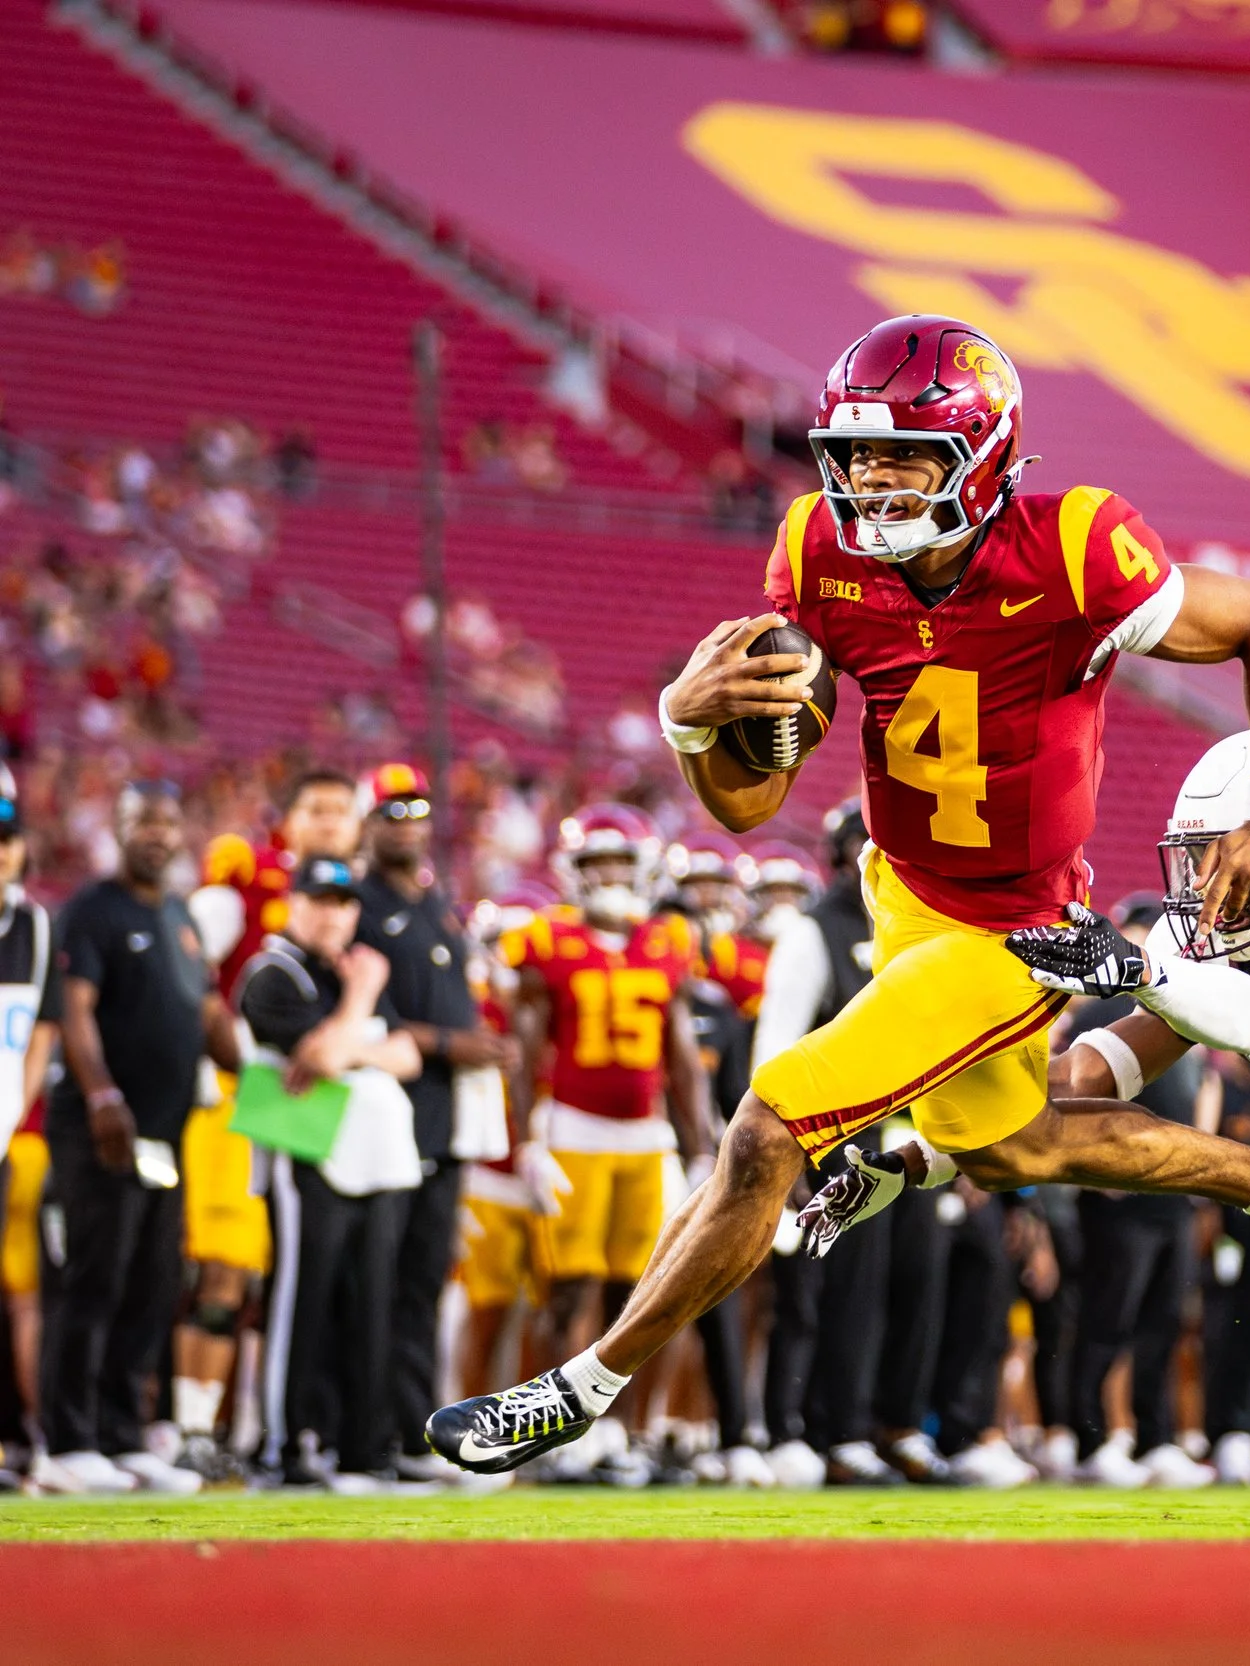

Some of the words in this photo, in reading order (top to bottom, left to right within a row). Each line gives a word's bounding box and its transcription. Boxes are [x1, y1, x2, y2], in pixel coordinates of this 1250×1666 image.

[851, 405, 861, 421] SC
[826, 455, 849, 486] ROJANS
[1109, 522, 1160, 585] 4
[918, 620, 934, 648] SC
[884, 664, 991, 848] 4
[1177, 819, 1205, 829] BEARS
[569, 968, 672, 1071] 15
